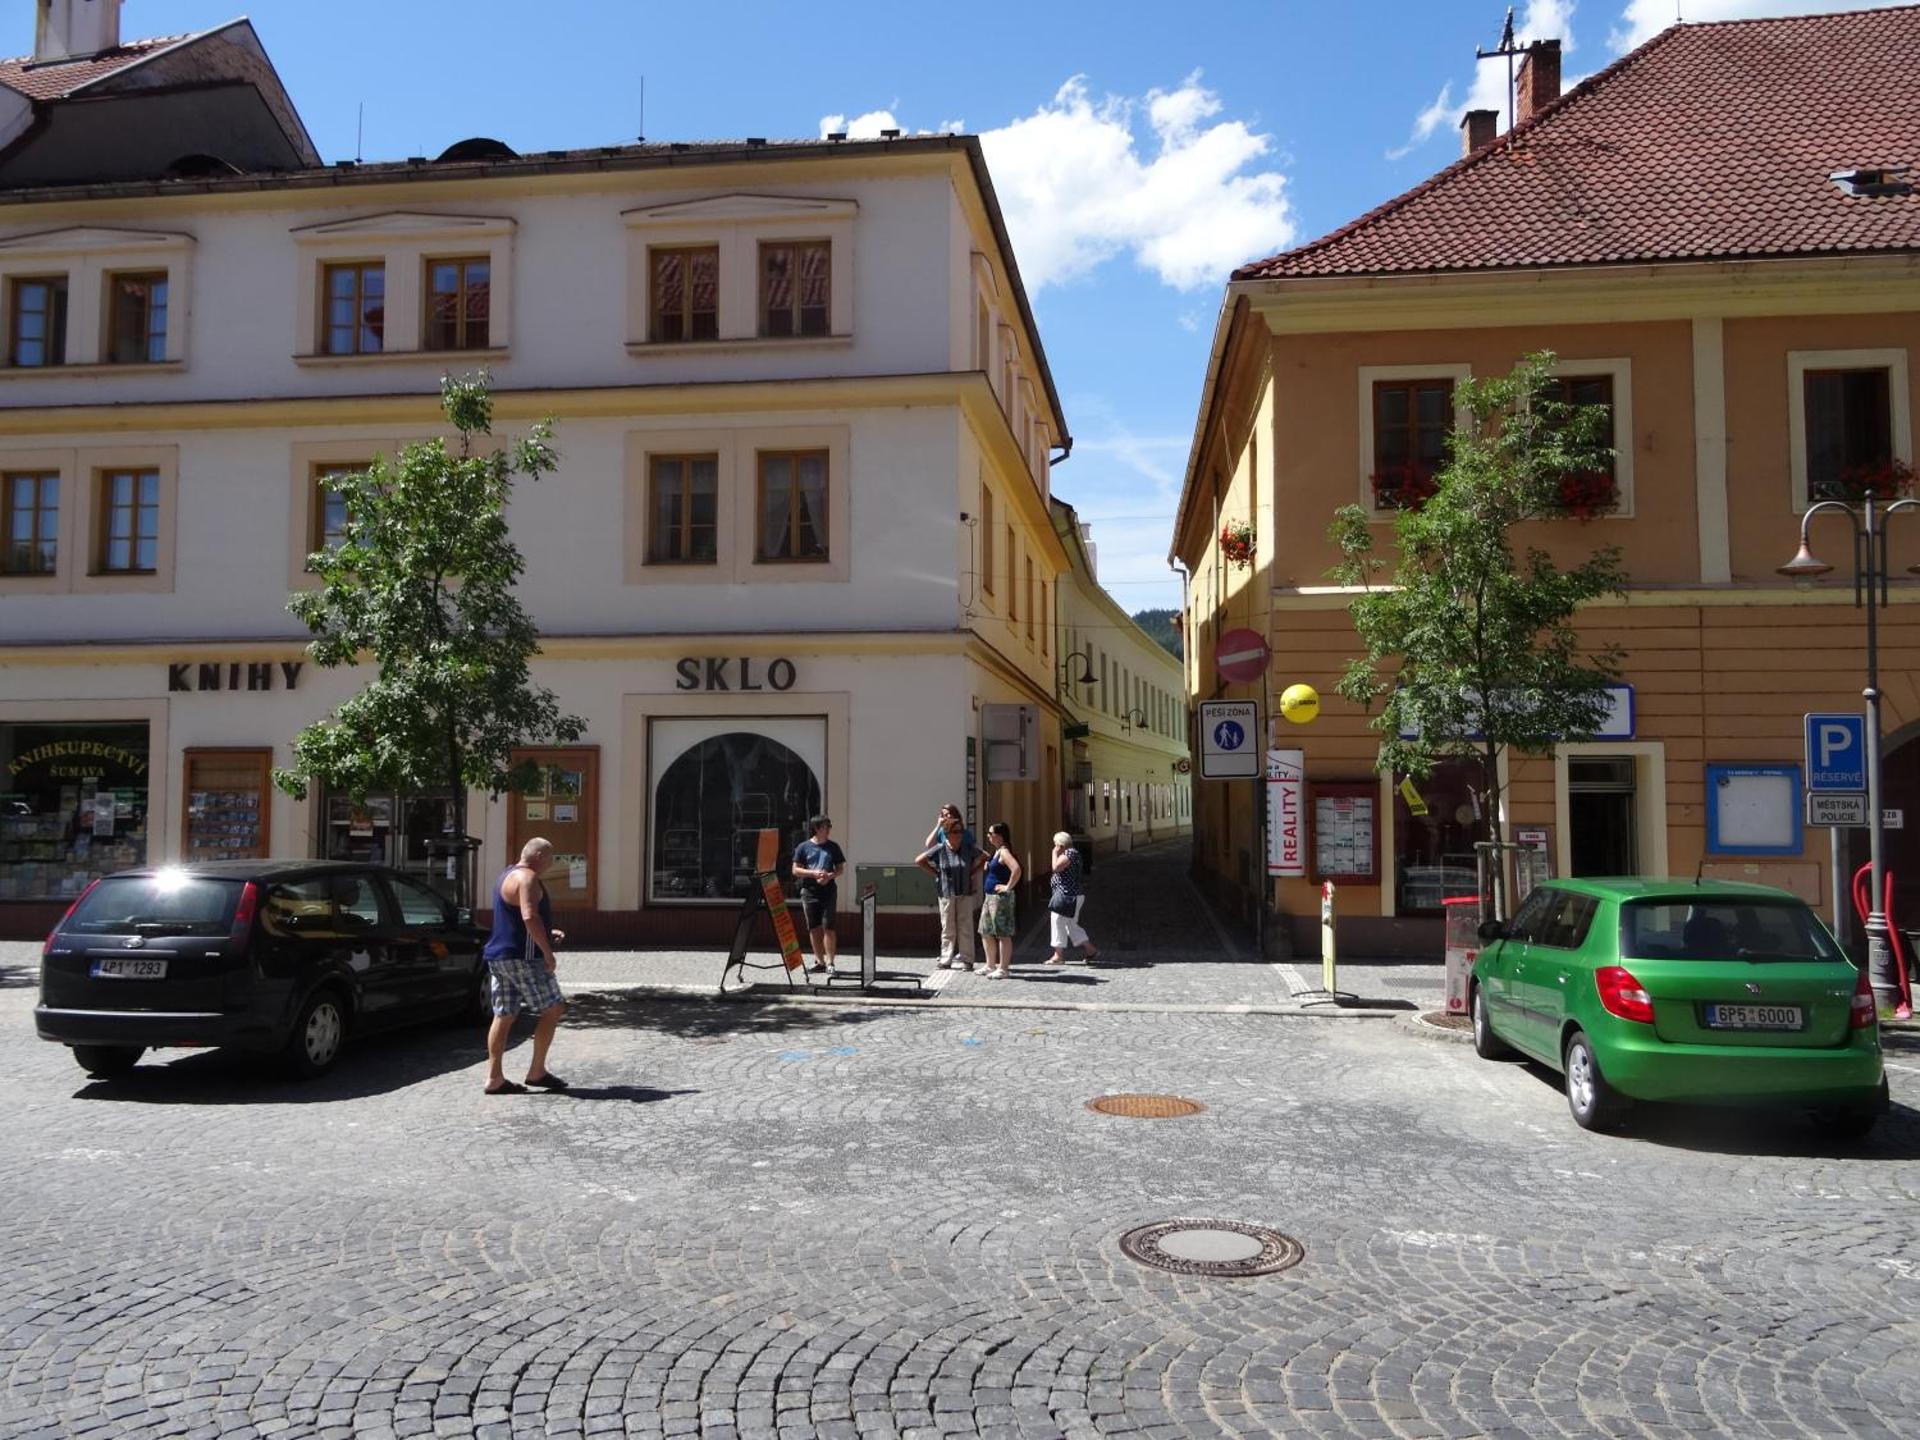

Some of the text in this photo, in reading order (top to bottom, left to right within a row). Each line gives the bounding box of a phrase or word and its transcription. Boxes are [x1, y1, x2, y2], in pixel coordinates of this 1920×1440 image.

[168, 662, 304, 692] KNIHY
[676, 657, 797, 691] SKLO
[1820, 724, 1853, 767] P
[1282, 787, 1298, 862] REALITY
[1820, 812, 1857, 821] POLICIE
[134, 960, 161, 975] 1293
[1718, 1007, 1796, 1024] 6P5 6000
